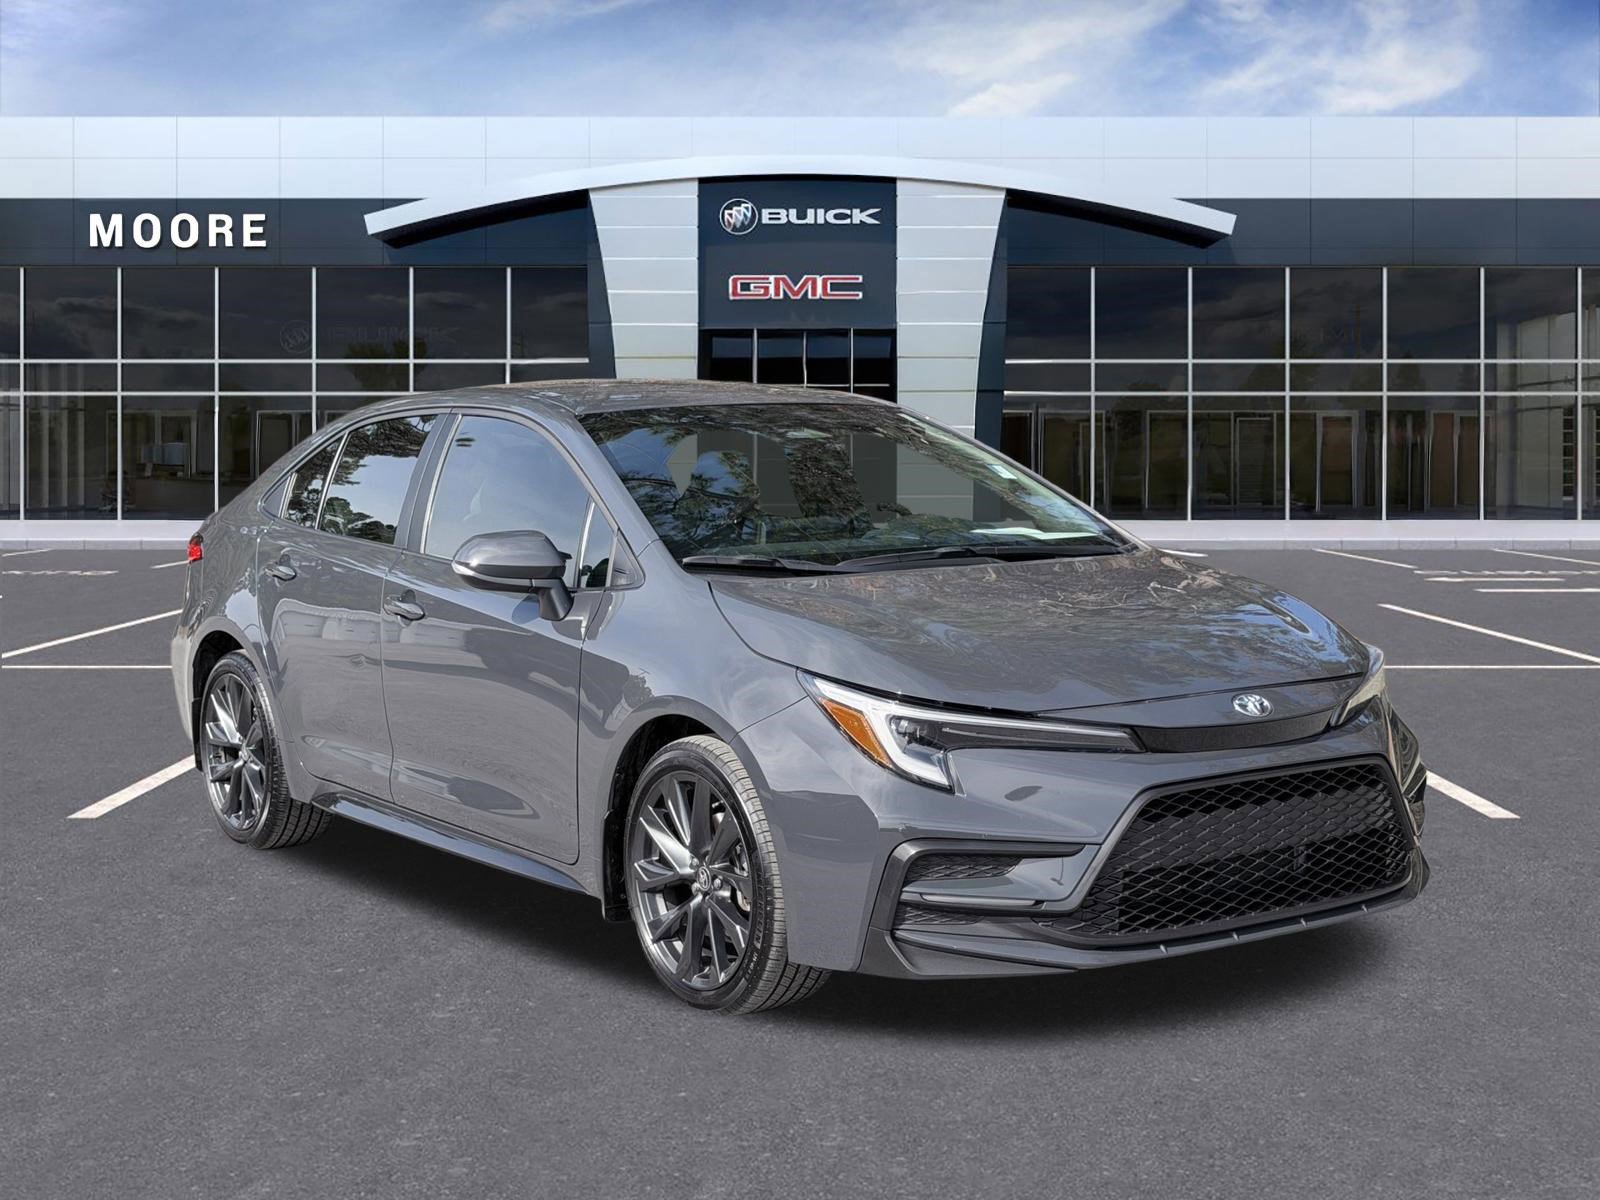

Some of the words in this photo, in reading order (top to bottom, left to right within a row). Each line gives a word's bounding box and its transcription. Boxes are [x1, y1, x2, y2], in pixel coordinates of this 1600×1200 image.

[762, 208, 882, 225] BUICK
[90, 213, 267, 248] MOORE
[729, 275, 863, 300] GMC
